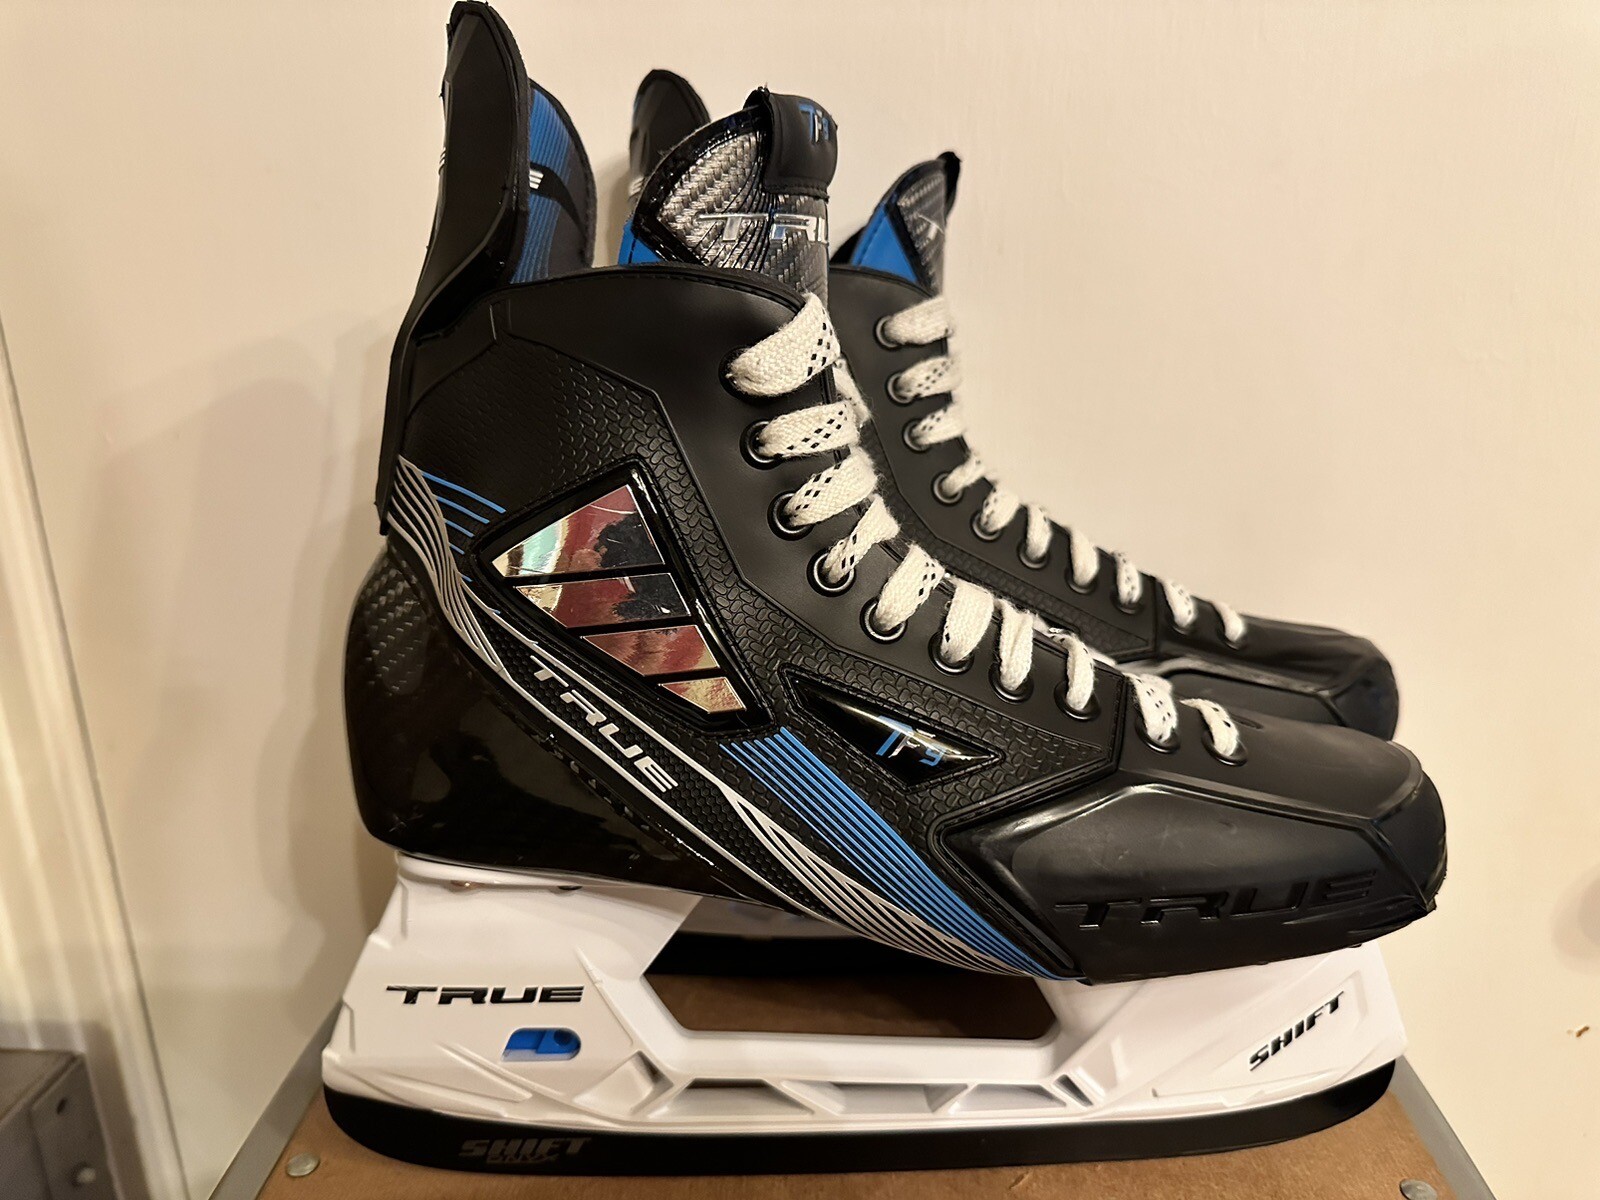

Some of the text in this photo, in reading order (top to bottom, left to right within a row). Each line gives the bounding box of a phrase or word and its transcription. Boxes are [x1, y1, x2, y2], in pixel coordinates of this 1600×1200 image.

[530, 655, 679, 793] TRUE
[1053, 870, 1377, 930] TRUE
[386, 985, 585, 1005] TRUE
[1249, 991, 1344, 1072] SHIFT
[458, 1137, 592, 1157] SHIFT
